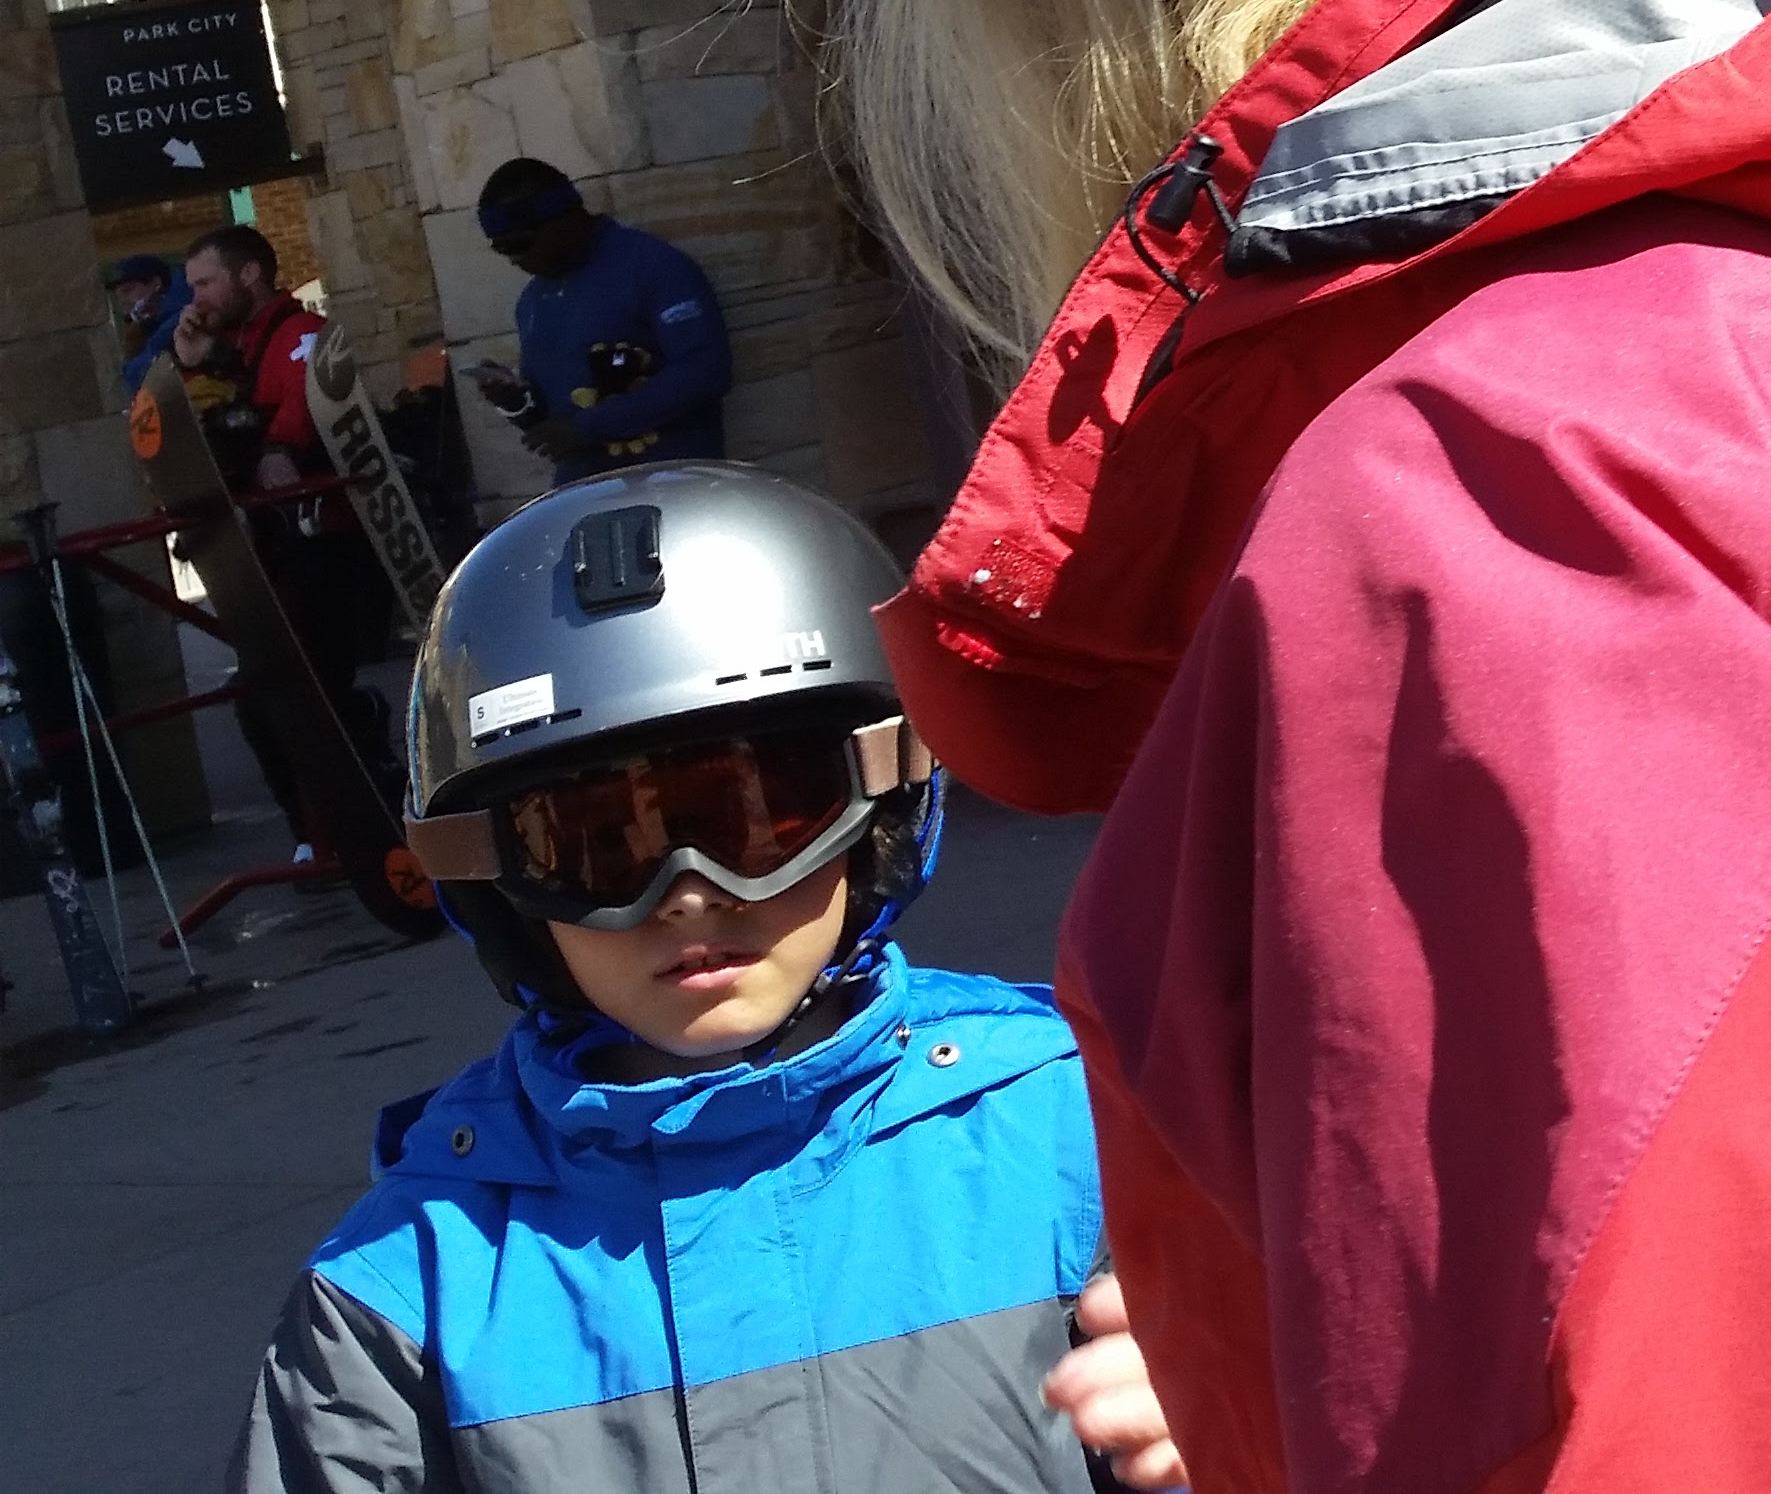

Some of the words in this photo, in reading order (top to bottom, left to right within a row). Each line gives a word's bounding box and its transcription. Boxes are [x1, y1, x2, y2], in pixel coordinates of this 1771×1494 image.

[123, 21, 179, 43] PARK
[187, 12, 237, 34] CITY
[105, 59, 230, 98] RENTAL
[94, 91, 253, 137] SERVICES
